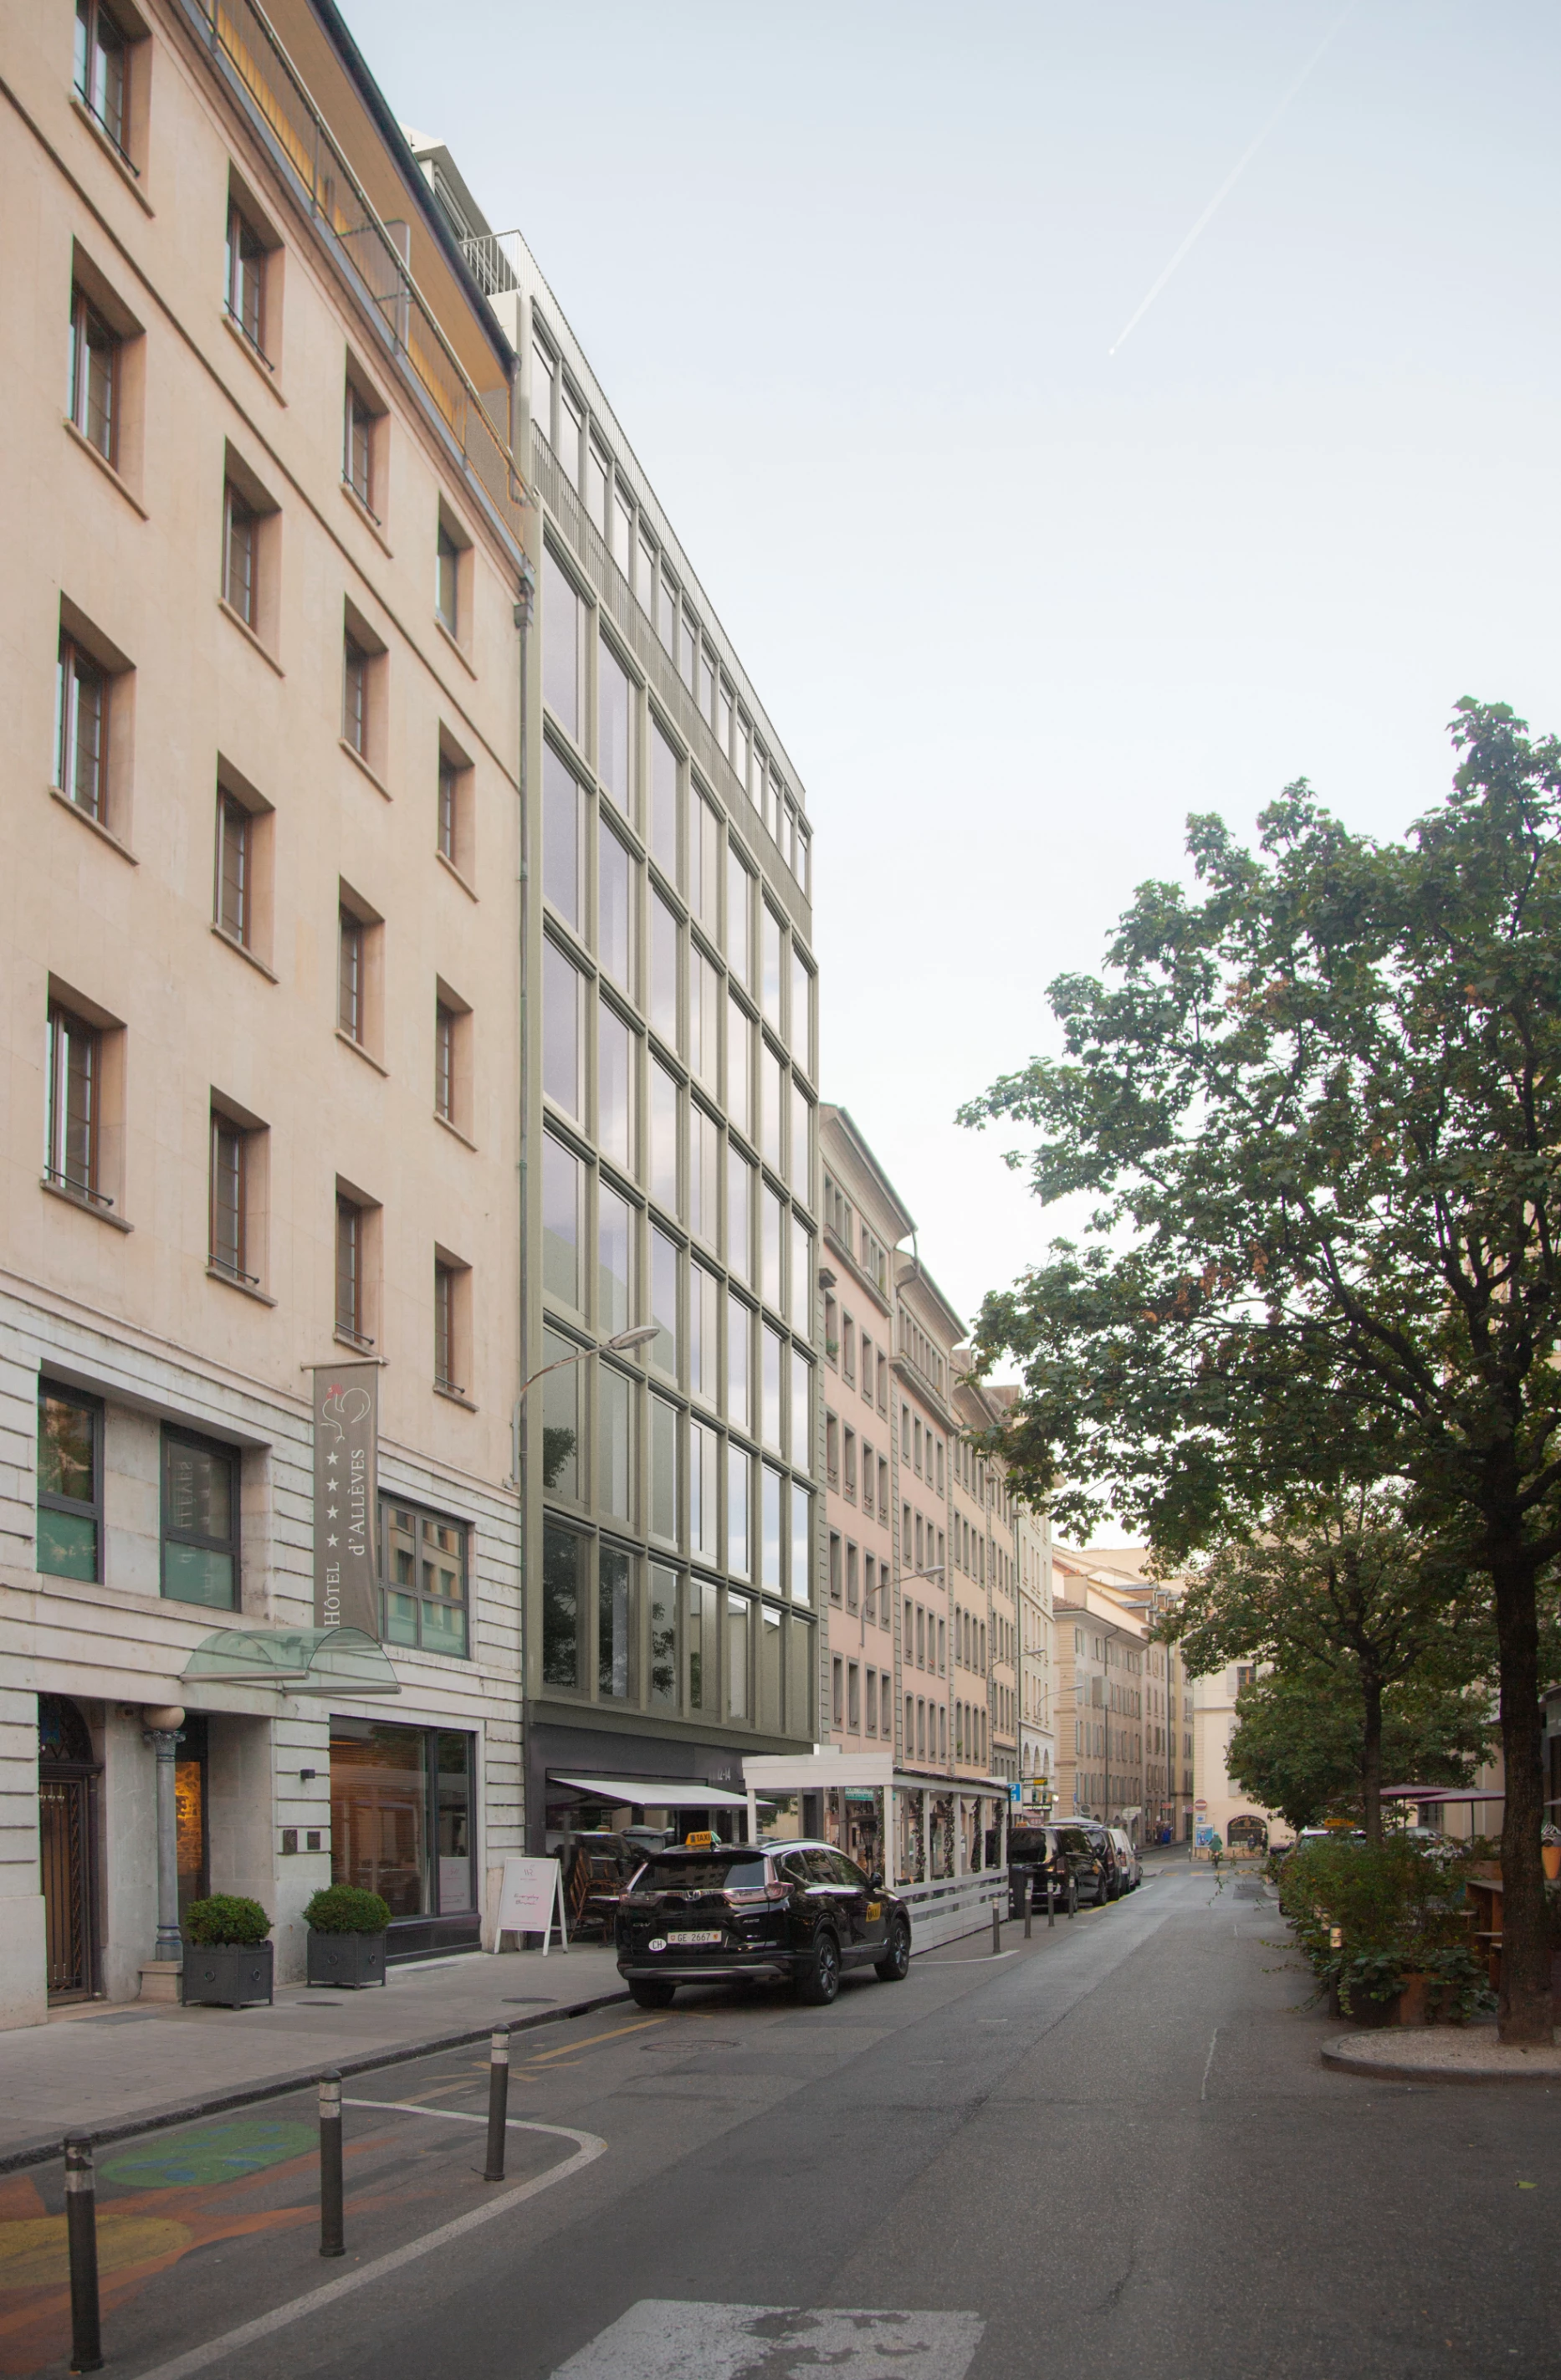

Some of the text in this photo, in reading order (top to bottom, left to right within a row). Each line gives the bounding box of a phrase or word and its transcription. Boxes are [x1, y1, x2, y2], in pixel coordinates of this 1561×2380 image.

[324, 1561, 340, 1627] HÔTEL
[696, 1833, 710, 1842] TAXI
[678, 1932, 711, 1942] GE 2667
[653, 1941, 663, 1950] CH
